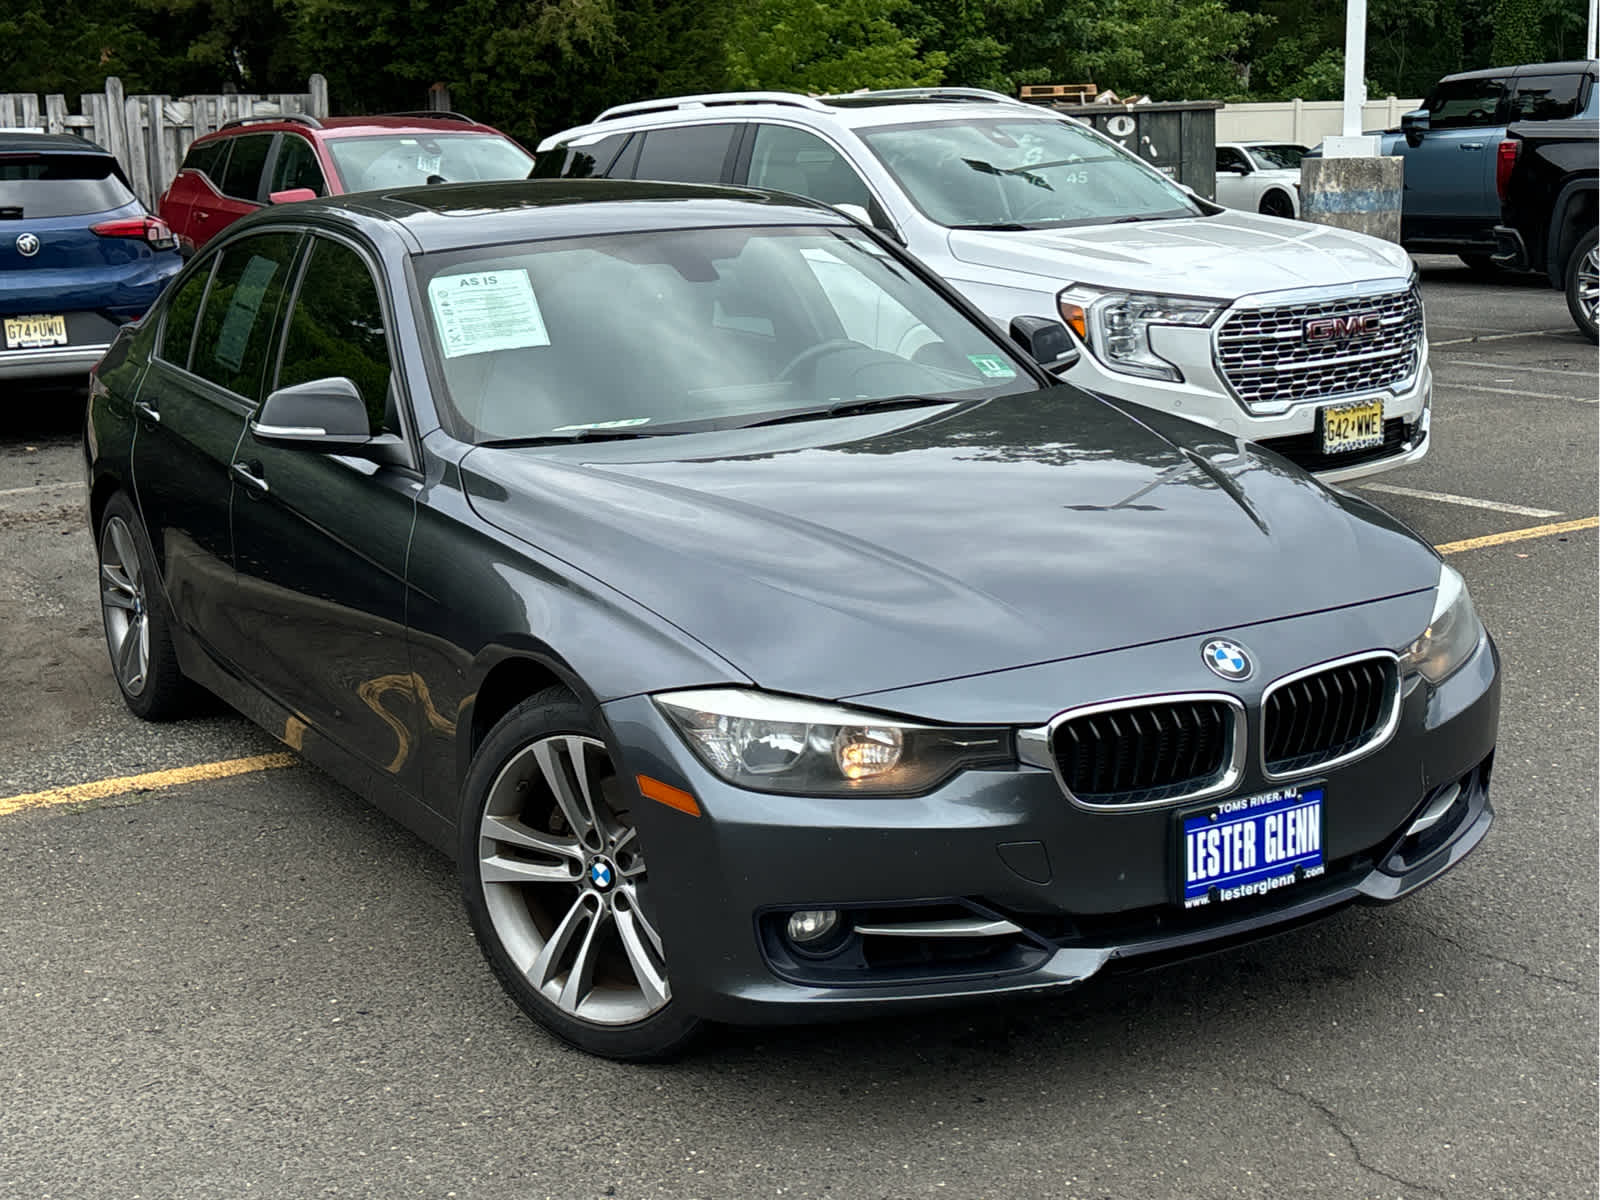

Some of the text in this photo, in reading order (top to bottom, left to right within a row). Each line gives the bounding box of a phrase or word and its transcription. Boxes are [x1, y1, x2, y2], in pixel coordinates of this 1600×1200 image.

[460, 276, 498, 287] AS IS
[1306, 314, 1381, 341] GMC
[1327, 417, 1349, 441] G42
[1218, 799, 1248, 815] TOMS
[1187, 804, 1320, 882] LESTER GLENN
[1220, 873, 1296, 902] lesterglenn
